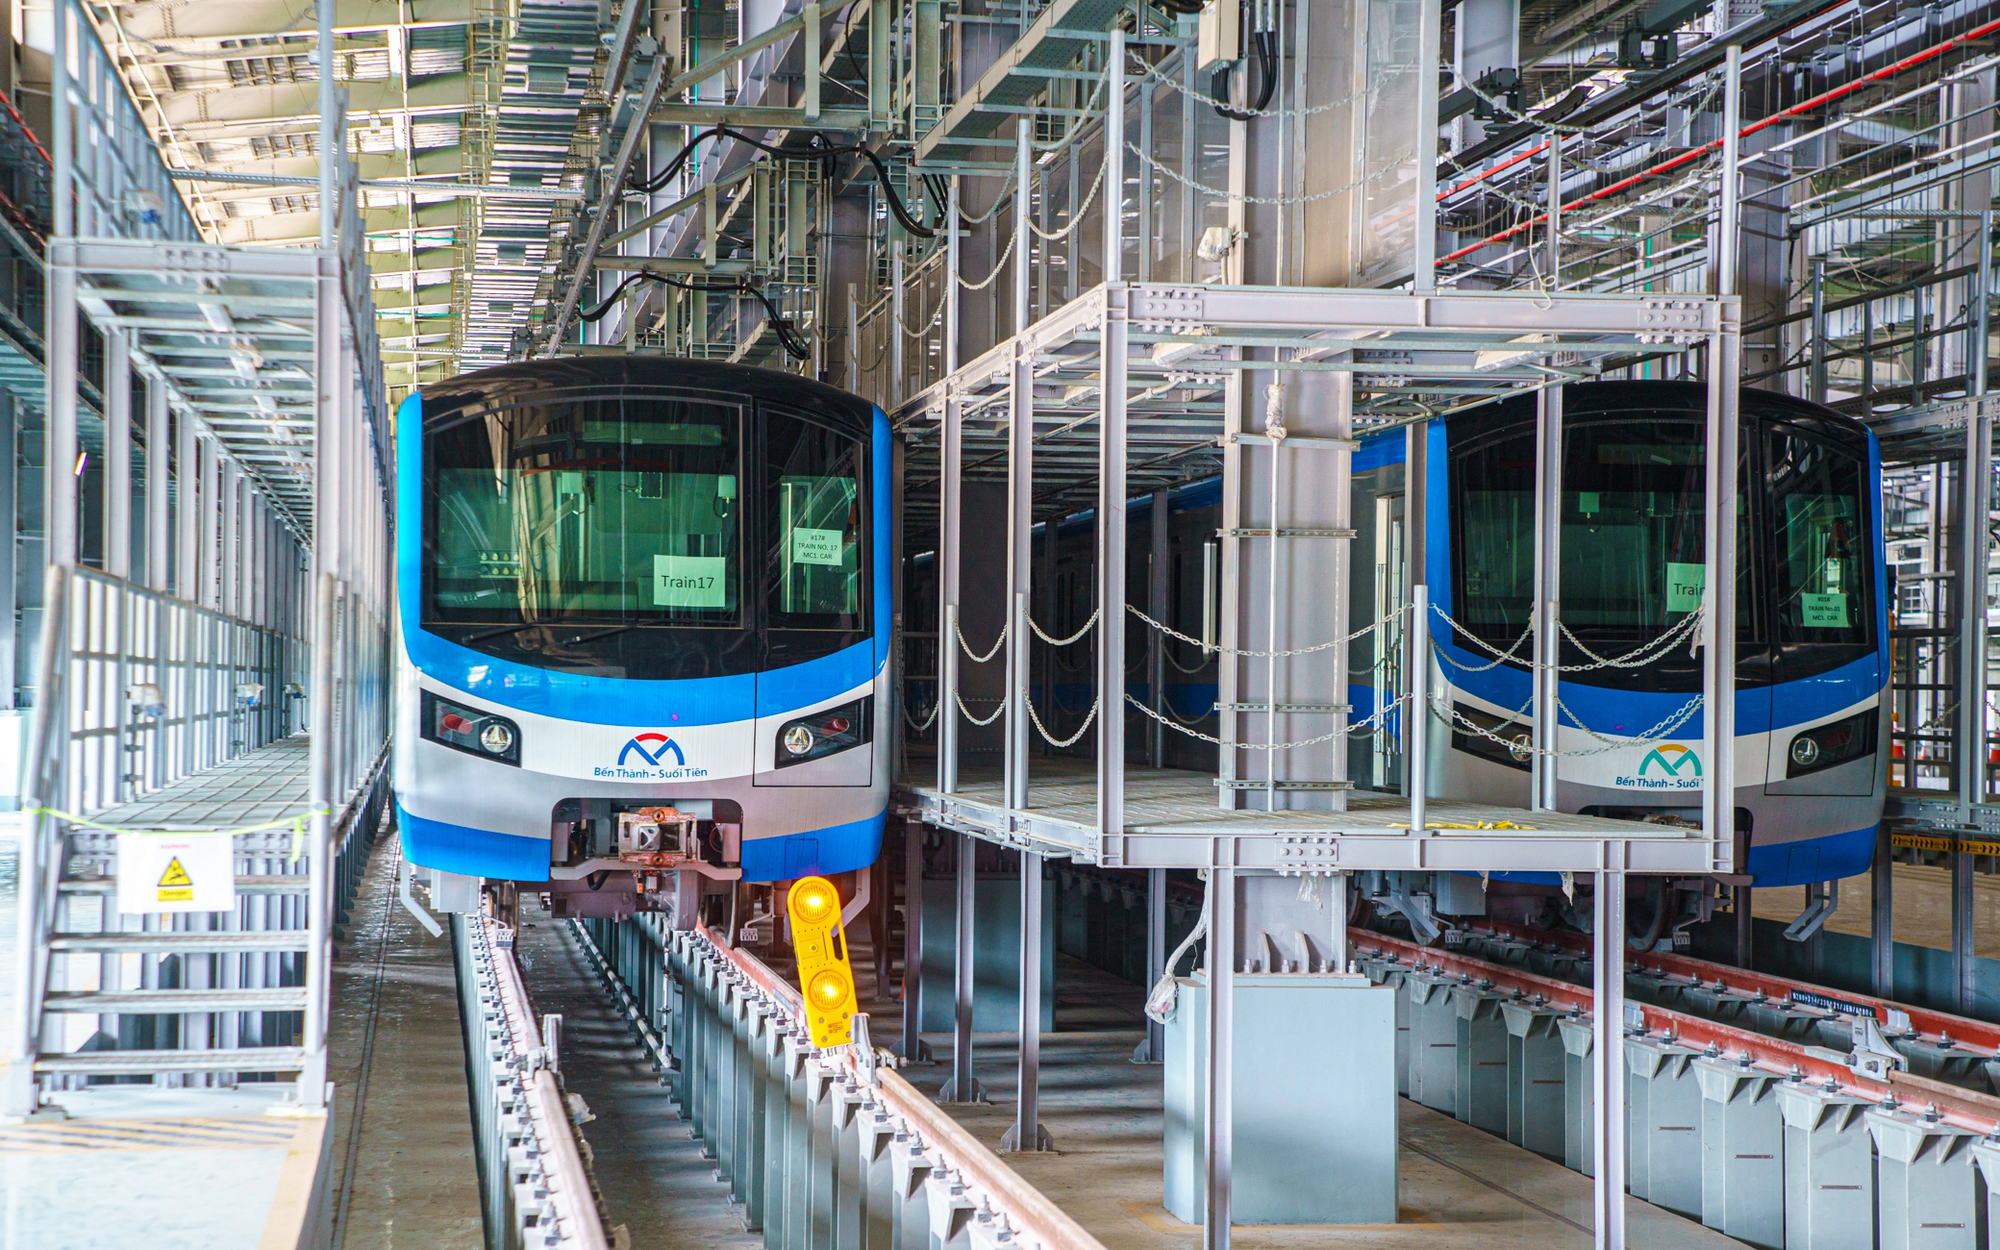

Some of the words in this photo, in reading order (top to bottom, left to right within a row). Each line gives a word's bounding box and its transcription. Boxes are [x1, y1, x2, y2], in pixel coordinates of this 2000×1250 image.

[798, 542, 816, 550] TRAIN
[661, 575, 714, 590] Train17
[594, 766, 614, 777] Bến
[616, 768, 649, 779] Thành
[659, 767, 683, 778] Suối
[684, 767, 708, 778] Tiên
[1615, 776, 1635, 787] Bến
[1636, 778, 1668, 788] Thành
[1676, 777, 1699, 788] Suối
